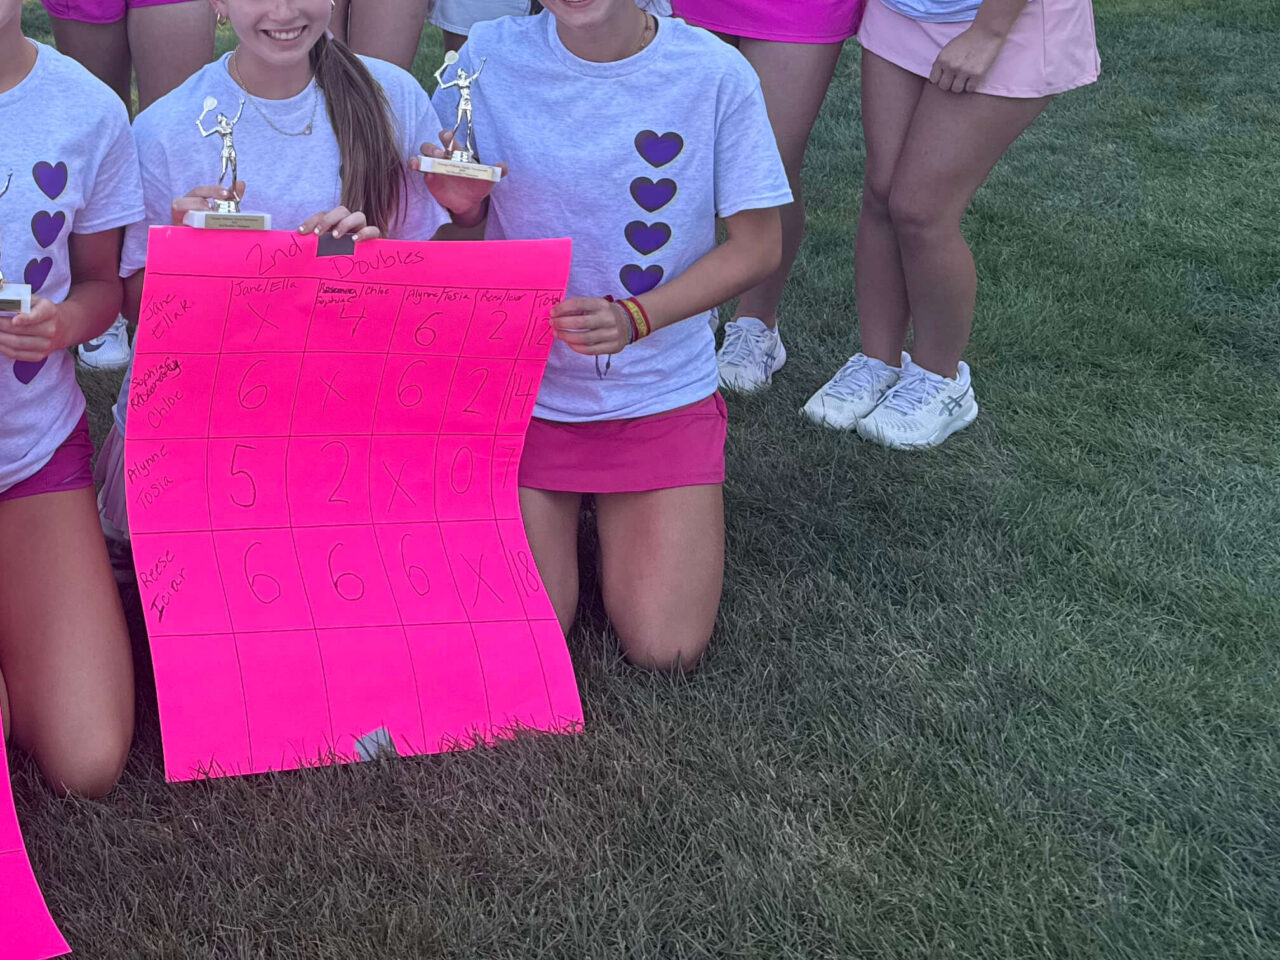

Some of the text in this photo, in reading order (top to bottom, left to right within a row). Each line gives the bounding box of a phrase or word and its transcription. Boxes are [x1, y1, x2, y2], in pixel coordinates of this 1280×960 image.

[246, 235, 425, 279] 2nd Doubles
[339, 304, 366, 336] 4
[414, 312, 443, 346] 6
[489, 310, 508, 340] 2
[528, 316, 552, 346] 12
[238, 360, 268, 409] 6
[398, 360, 428, 407] 6
[463, 367, 490, 415] 2
[147, 391, 184, 429] Chloe
[230, 444, 257, 507] 5
[321, 441, 349, 503] 2
[451, 446, 473, 494] 0
[500, 447, 515, 488] 7
[136, 476, 174, 510] Tosia
[139, 550, 176, 589] Reese
[244, 542, 281, 603] 6
[328, 543, 364, 601] 6
[402, 533, 430, 596] 6
